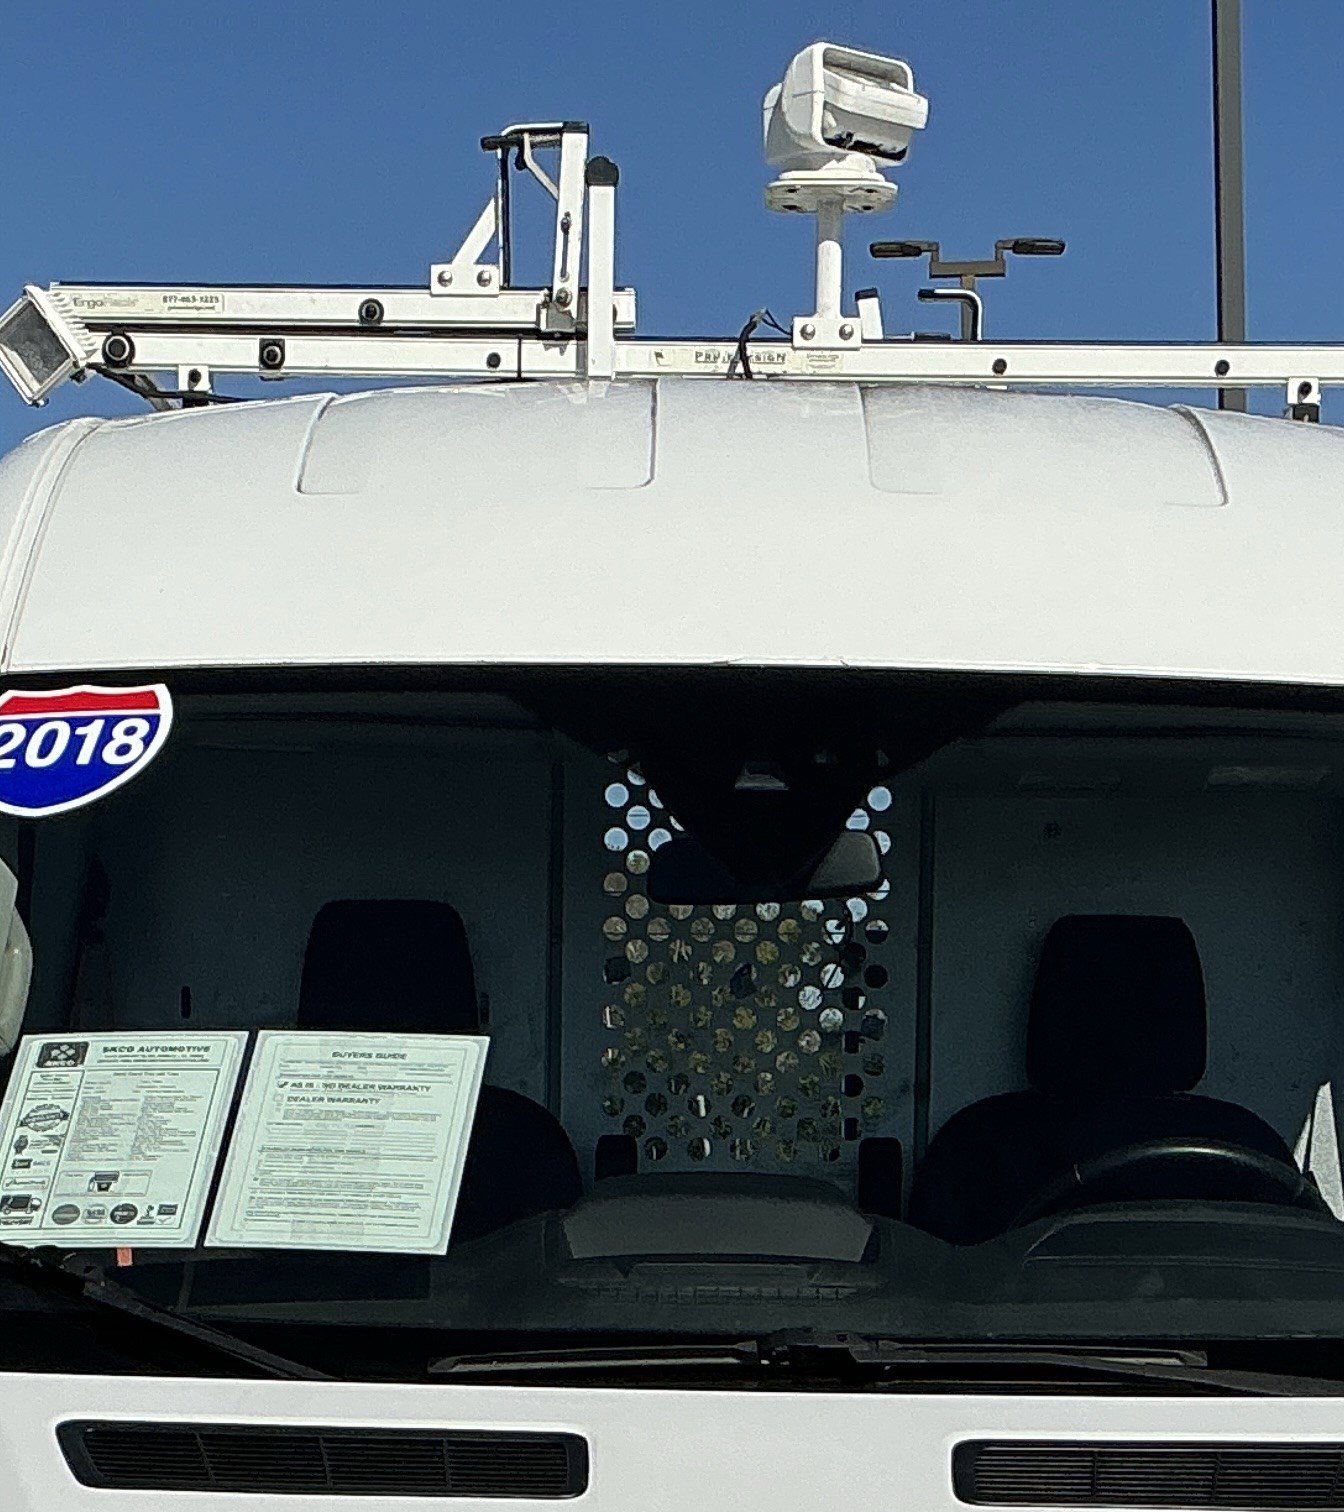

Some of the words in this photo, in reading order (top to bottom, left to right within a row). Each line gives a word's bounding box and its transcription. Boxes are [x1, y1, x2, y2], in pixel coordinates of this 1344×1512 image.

[331, 1051, 373, 1059] BUYERS
[375, 1052, 408, 1060] GUIDE
[338, 1082, 376, 1090] DEALER
[377, 1083, 431, 1093] WARRANTY
[286, 1095, 325, 1103] DEALER
[326, 1096, 382, 1105] WARRANTY
